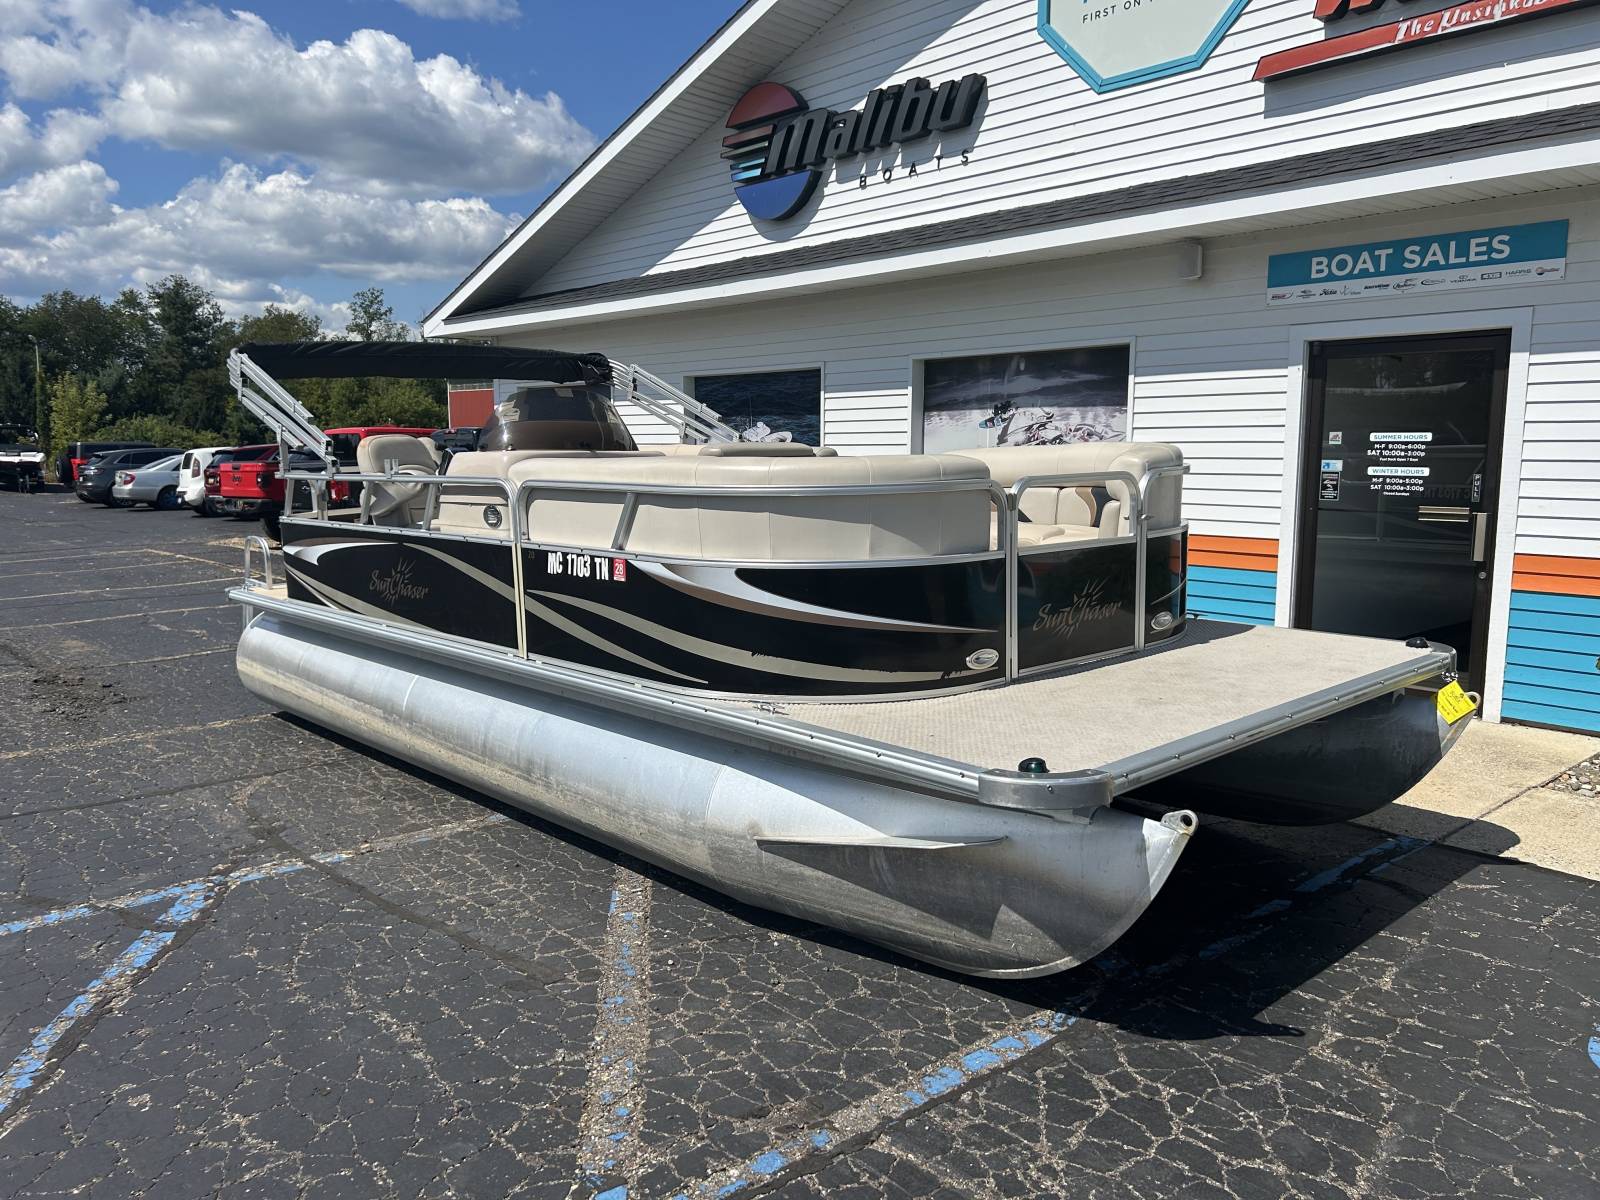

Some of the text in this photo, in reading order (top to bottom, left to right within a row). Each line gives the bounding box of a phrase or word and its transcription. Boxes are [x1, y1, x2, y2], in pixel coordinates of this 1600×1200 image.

[1082, 0, 1141, 24] FIRST ON
[1395, 20, 1434, 43] The
[761, 73, 986, 176] Malibu
[859, 149, 969, 187] BOATS
[1311, 234, 1511, 279] BOAT SALES
[547, 552, 609, 581] MC 1703 TN
[369, 568, 429, 600] SunChaser
[1033, 597, 1121, 632] SunChaser
